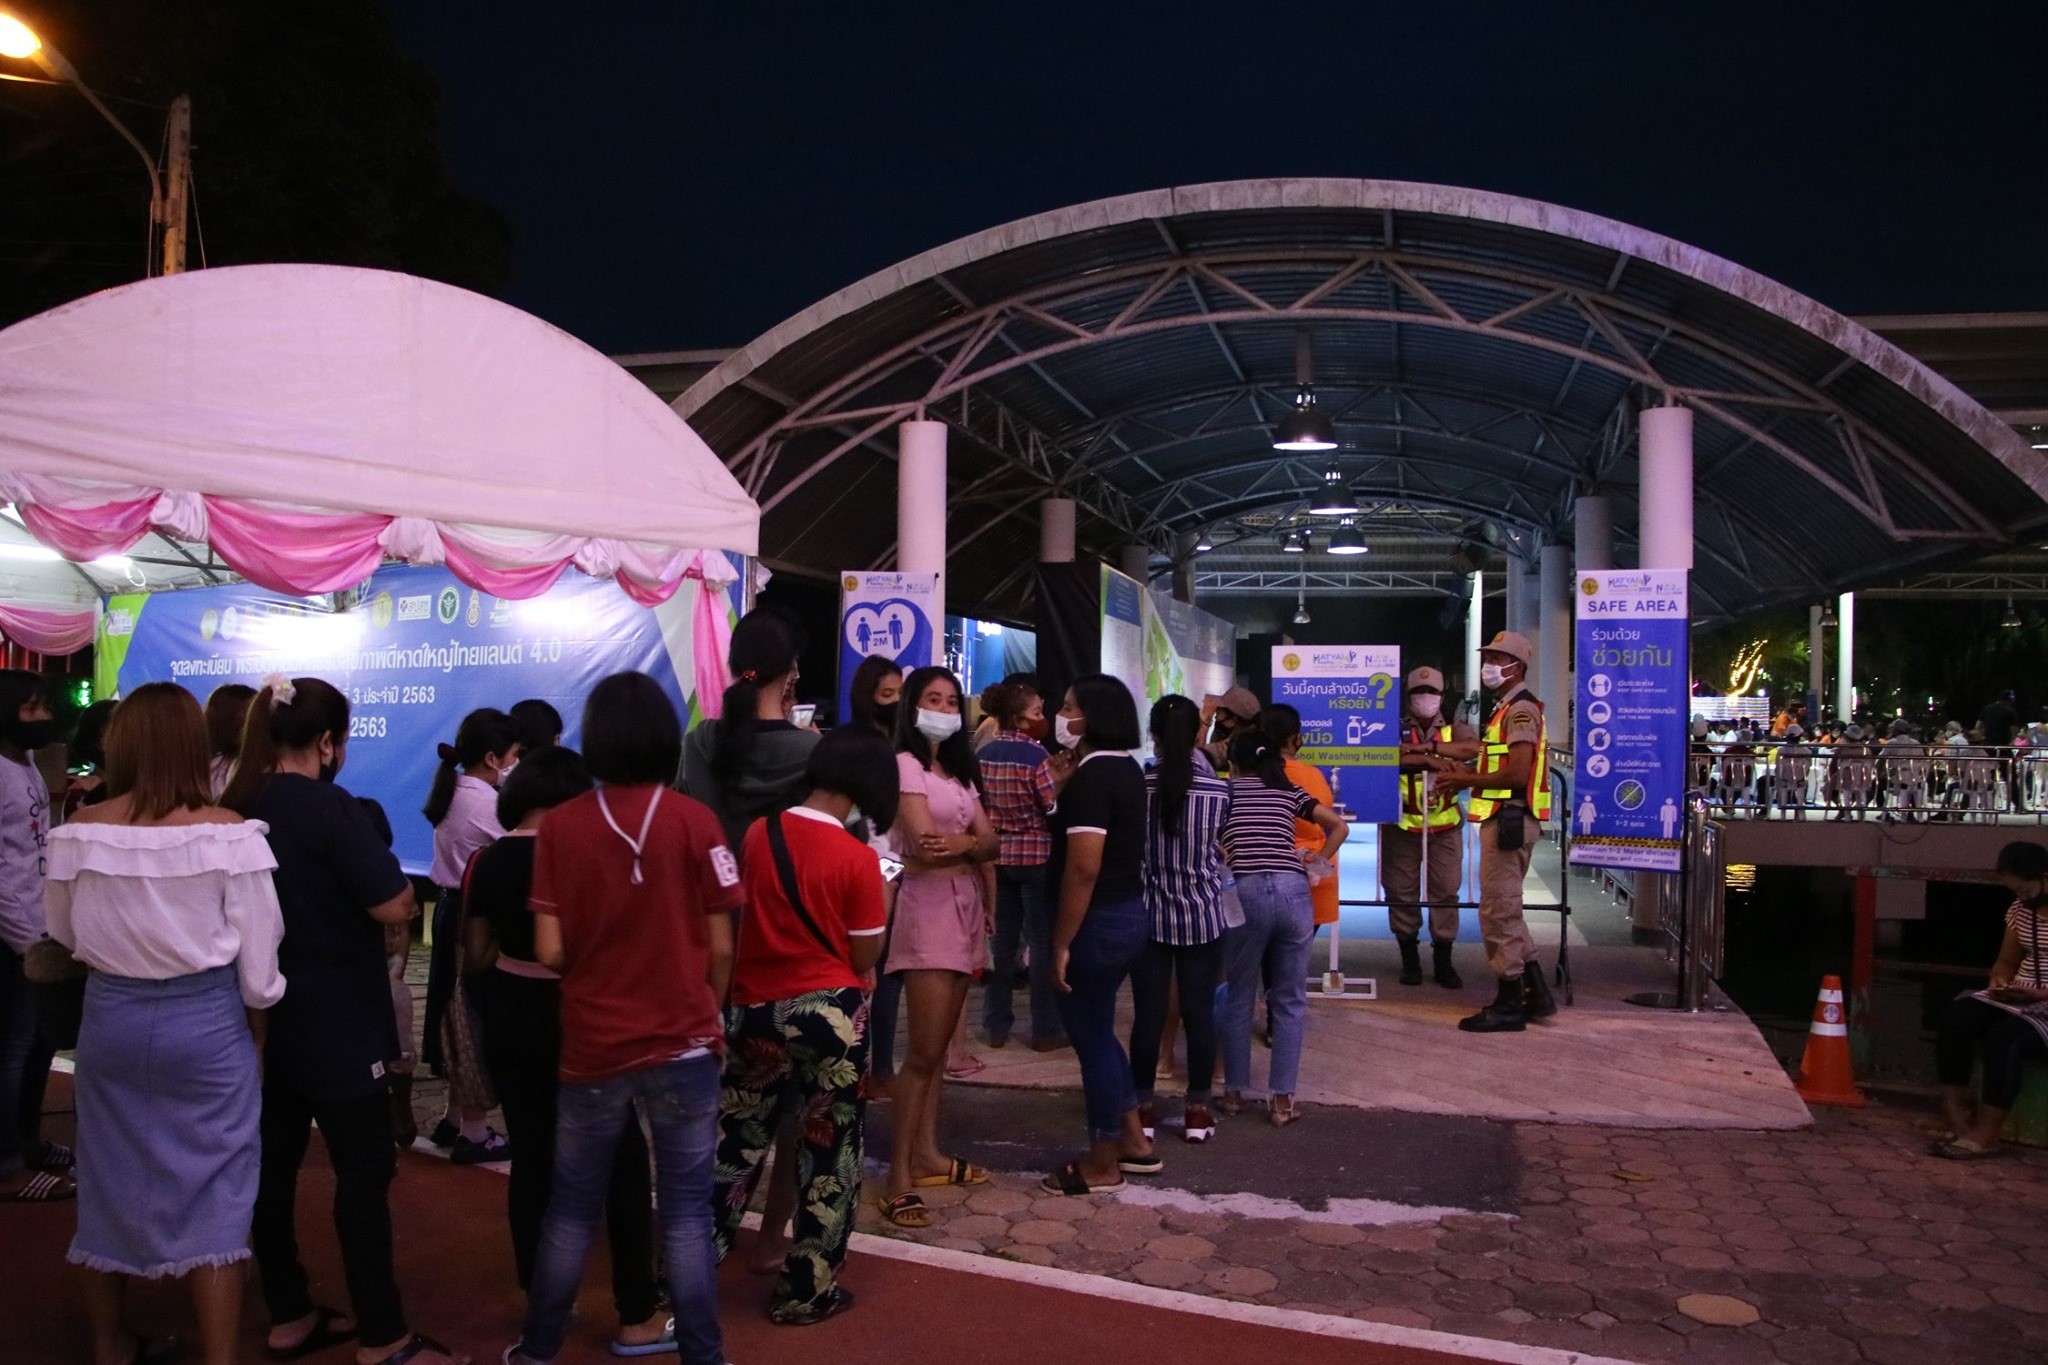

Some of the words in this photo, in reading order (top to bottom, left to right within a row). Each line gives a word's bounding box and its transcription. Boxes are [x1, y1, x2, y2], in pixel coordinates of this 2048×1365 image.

[1588, 600, 1627, 612] SAFE
[1635, 600, 1678, 612] AREA
[873, 637, 888, 646] 2M
[1591, 627, 1641, 640] ร่วมด้วย
[530, 635, 561, 663] 4.0
[1592, 643, 1672, 667] ช่วยกัน
[352, 687, 360, 704] 3
[363, 684, 399, 704] ประจำปี
[402, 685, 435, 704] 2563
[1283, 679, 1367, 698] วันนี้คุณล้างมือ
[1328, 696, 1372, 709] หรือยัง
[1368, 672, 1393, 709] ?
[349, 716, 387, 738] 2563
[1301, 728, 1333, 744] งมือ
[1319, 752, 1360, 762] Washing
[1363, 752, 1393, 760] Hands
[1578, 845, 1606, 853] Maintain
[1646, 849, 1676, 857] distance
